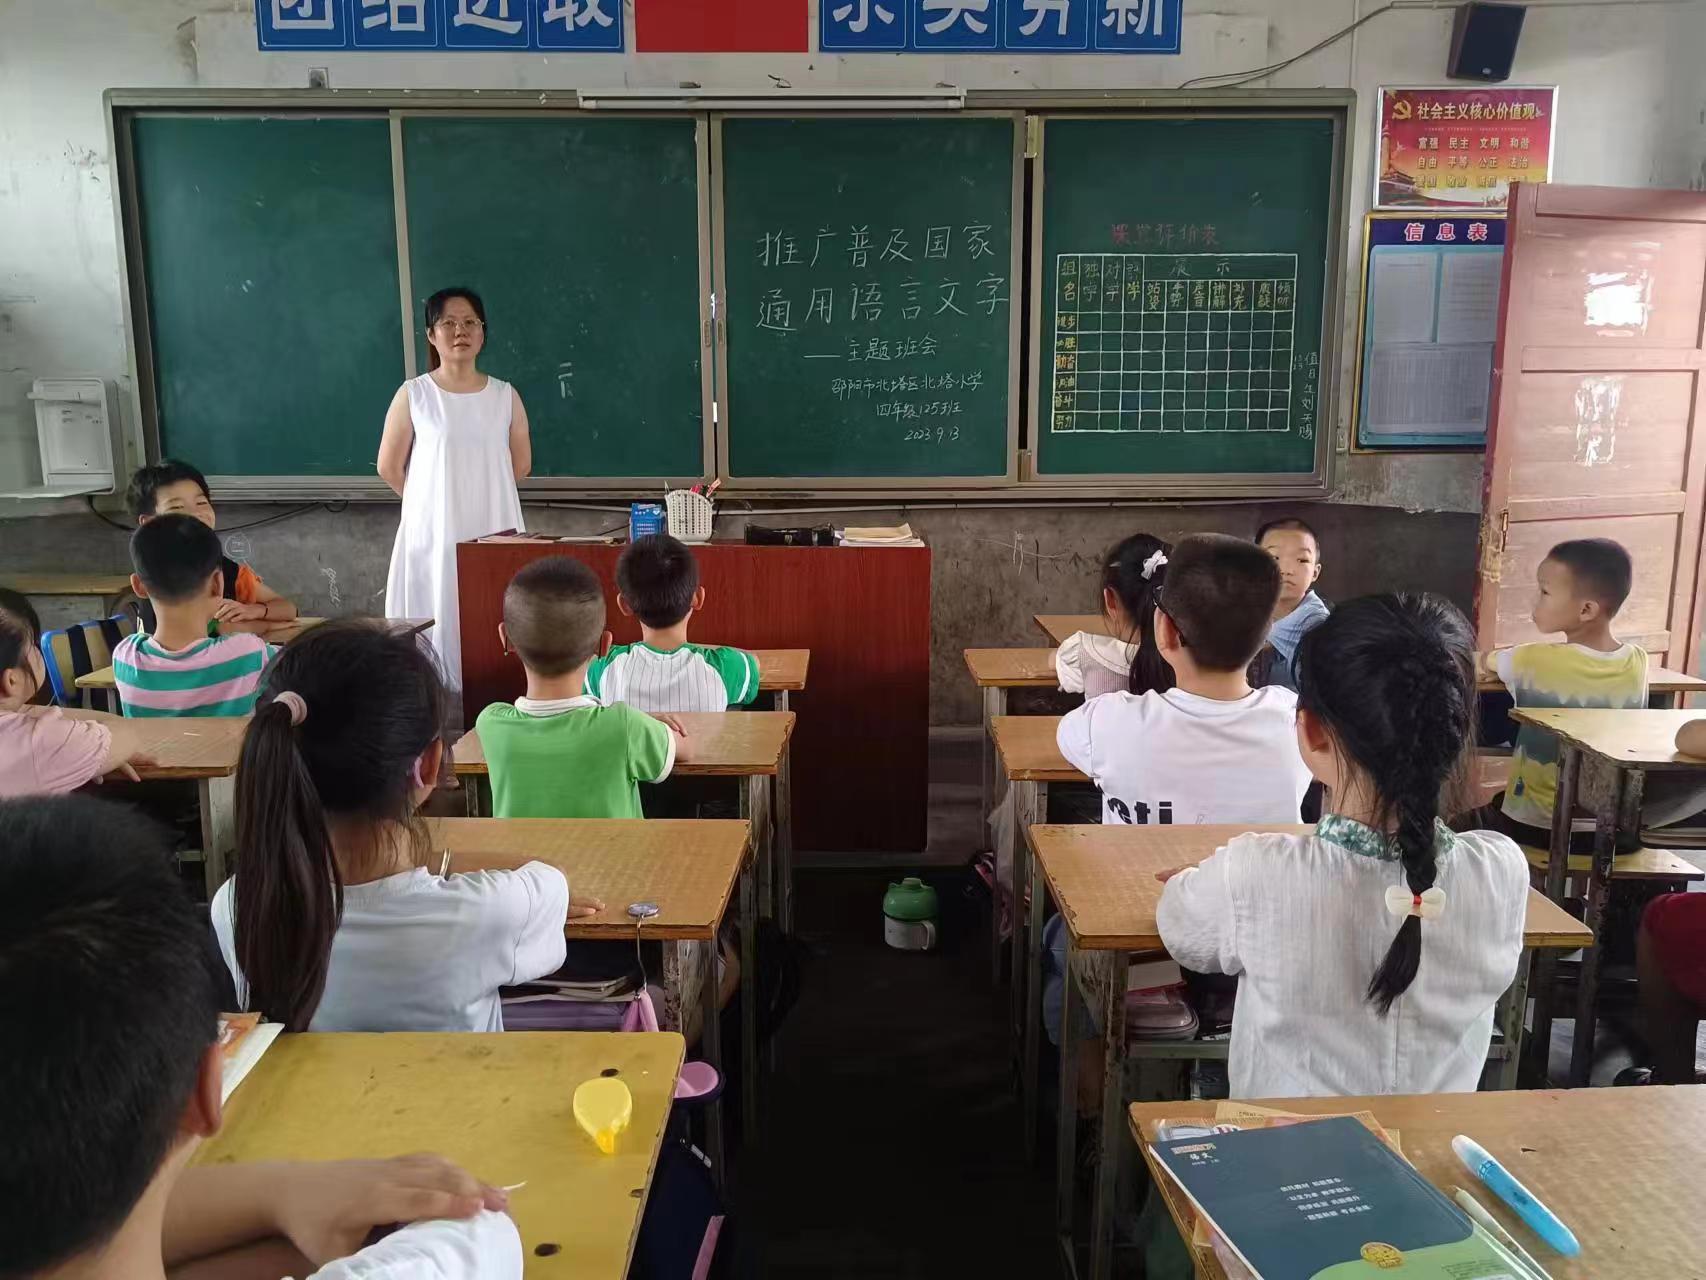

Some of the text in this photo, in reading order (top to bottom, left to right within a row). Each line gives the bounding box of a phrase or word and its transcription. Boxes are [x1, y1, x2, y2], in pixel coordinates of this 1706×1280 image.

[1417, 101, 1536, 120] 社会主义核心价值观
[1418, 137, 1440, 150] 富强
[1448, 137, 1469, 150] 民主
[1479, 137, 1500, 150] 文明
[1417, 156, 1438, 169] 自由
[1479, 156, 1498, 169] 公正
[1404, 222, 1488, 242] 信息表
[756, 220, 996, 268] 推广普及国家
[755, 273, 1010, 332] 通用语言文字
